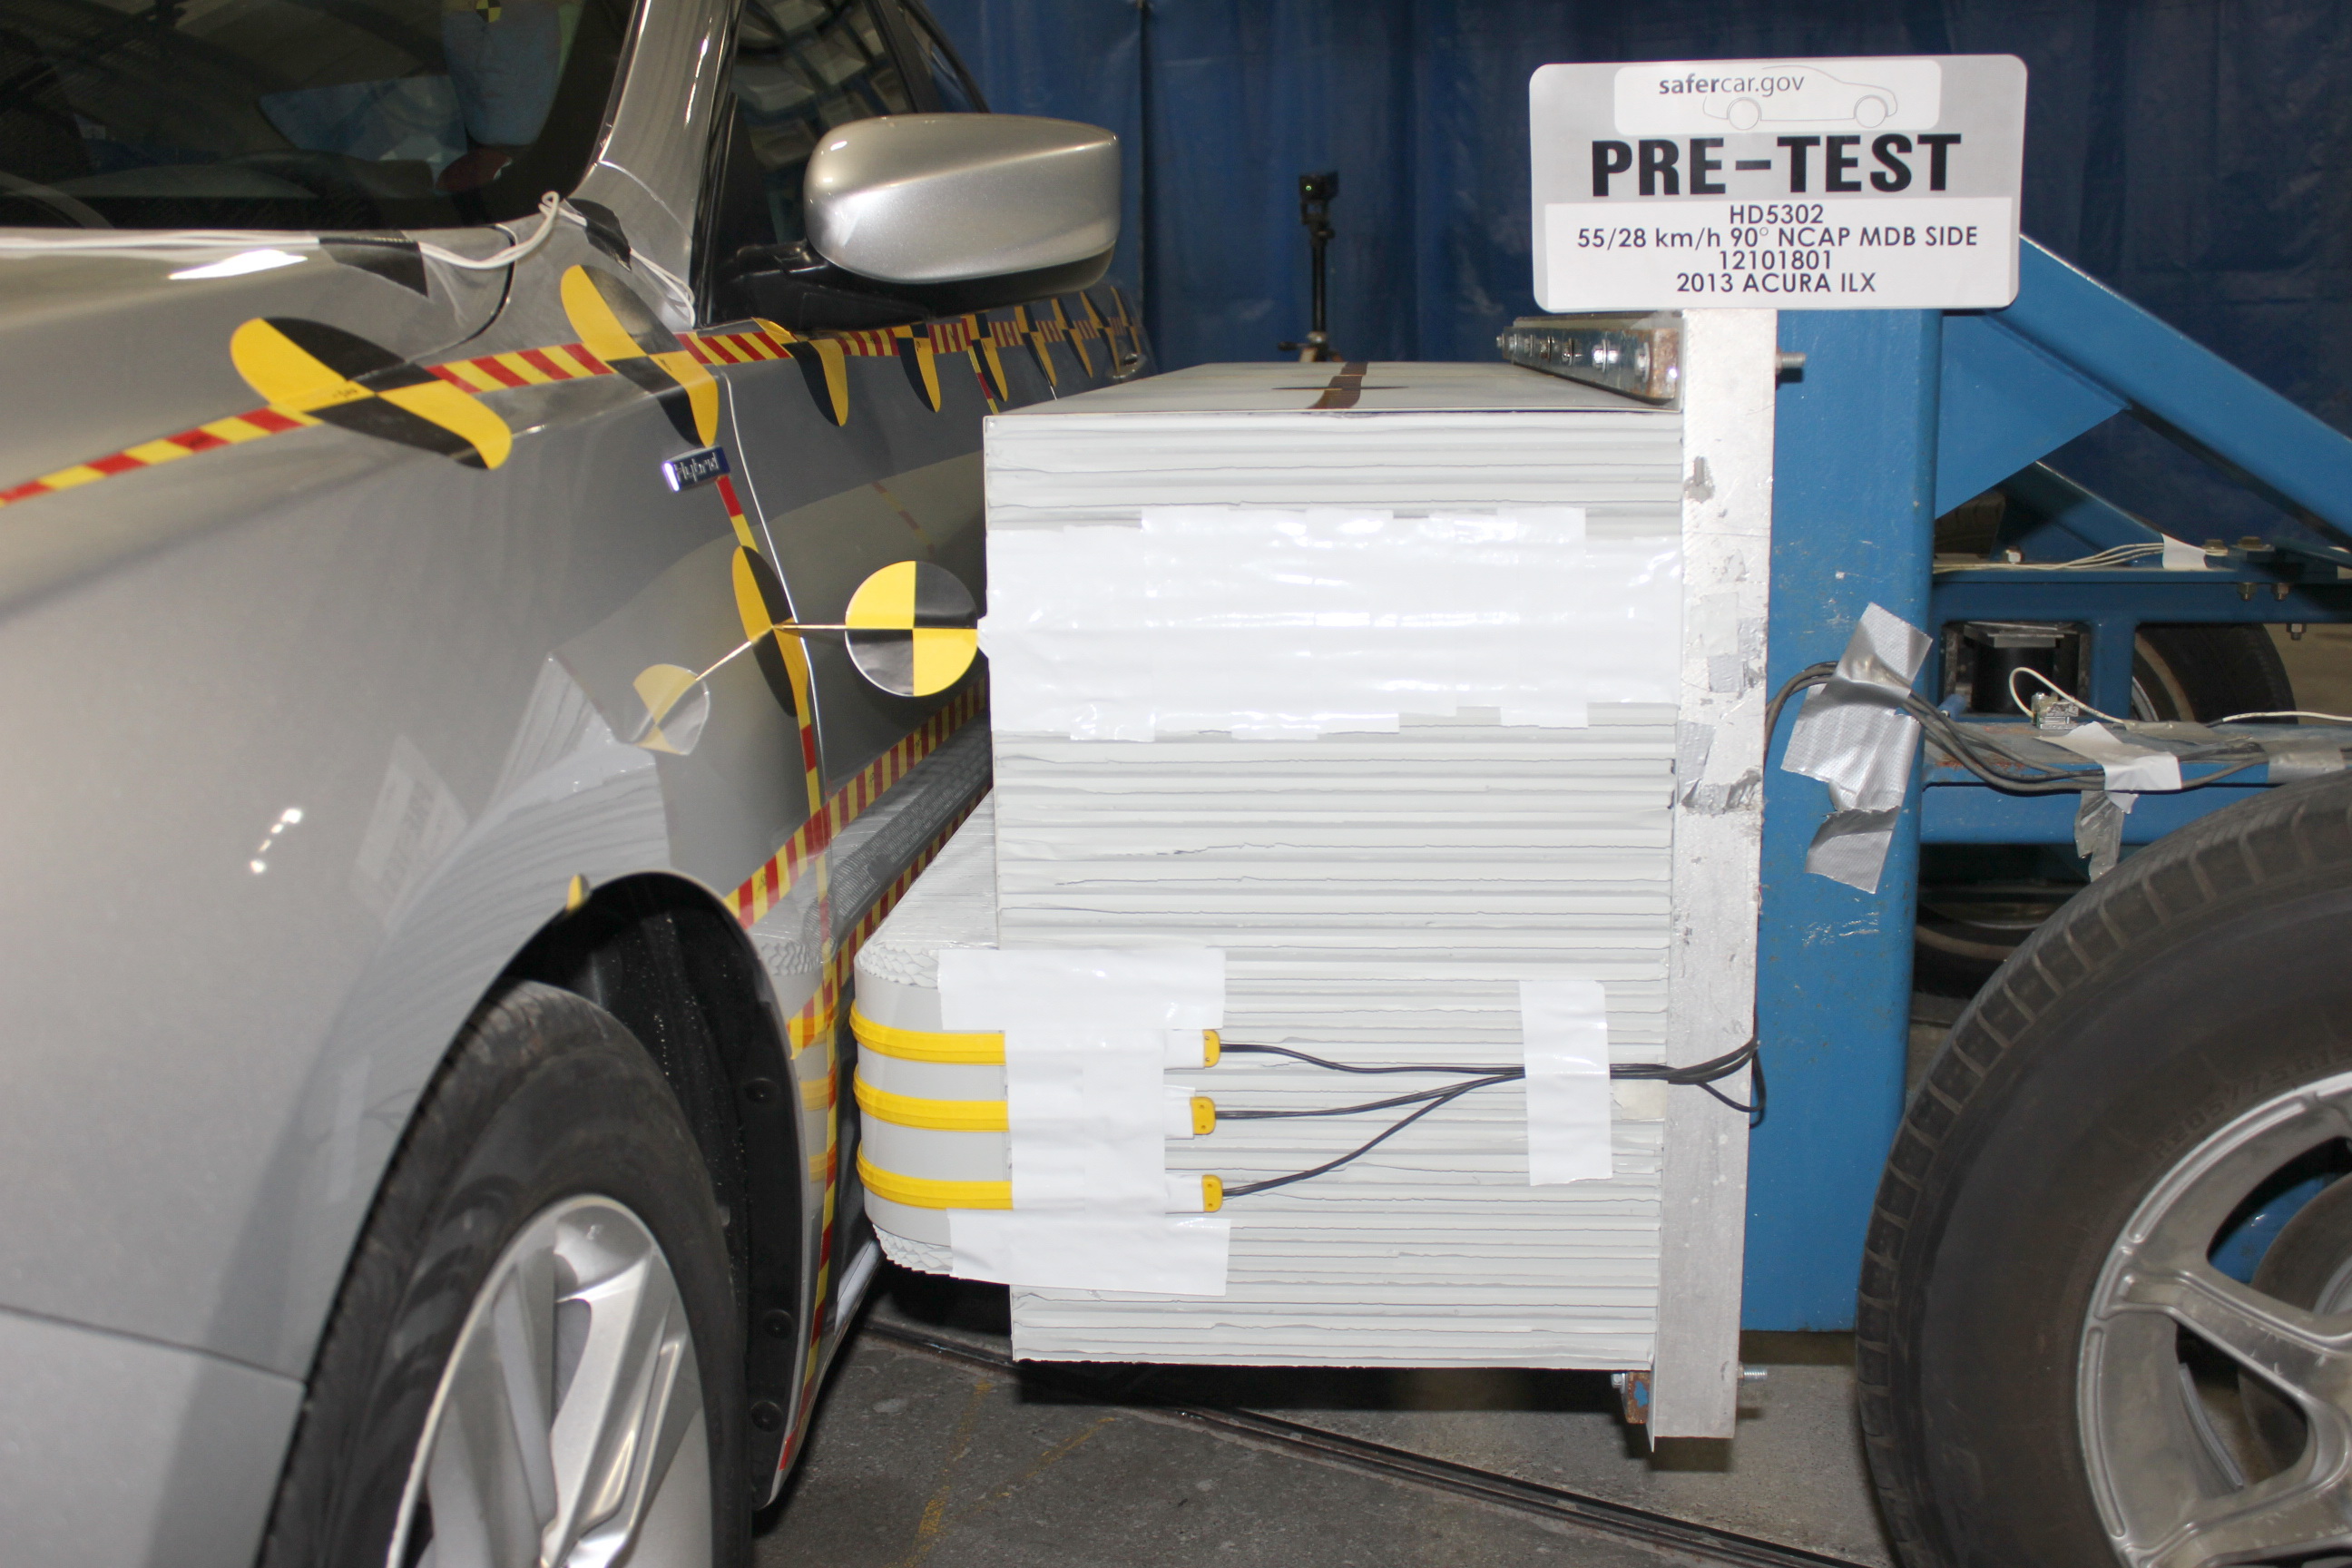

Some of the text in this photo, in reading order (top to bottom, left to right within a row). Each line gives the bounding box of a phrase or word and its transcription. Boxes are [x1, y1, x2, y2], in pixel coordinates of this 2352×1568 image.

[1659, 74, 1805, 97] safercar.gov
[1592, 133, 1962, 197] PRE-TEST
[1730, 204, 1824, 225] HD5302
[1577, 229, 1647, 250] 55/28
[1655, 228, 1720, 250] km/h
[1779, 227, 1850, 248] NCAP
[1859, 226, 1916, 247] MDB
[1925, 225, 1978, 247] SIDE
[1720, 250, 1831, 270] 12101801
[1677, 273, 1877, 293] 2013 ACURA ILX
[673, 451, 720, 483] Hybrid
